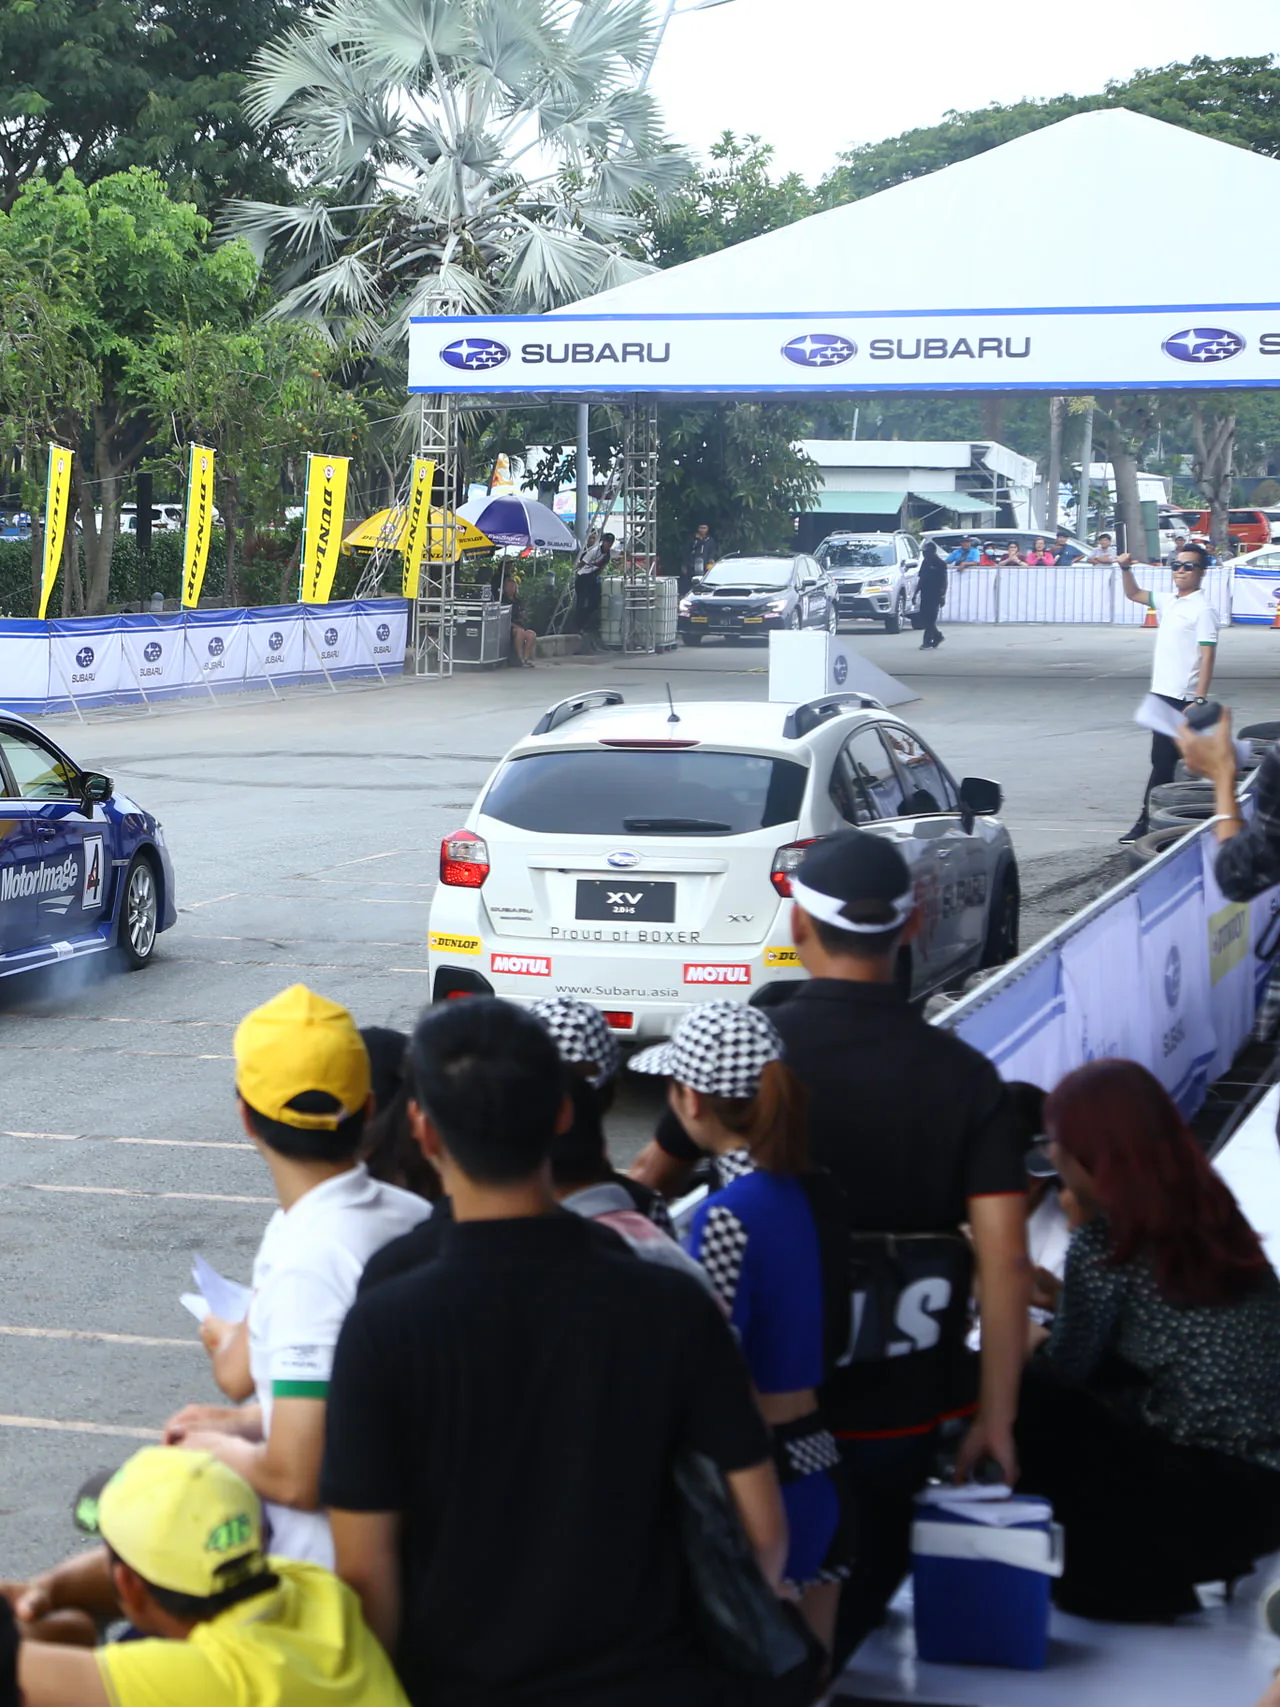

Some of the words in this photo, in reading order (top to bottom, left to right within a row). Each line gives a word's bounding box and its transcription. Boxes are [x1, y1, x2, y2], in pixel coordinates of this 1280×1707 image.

[521, 342, 671, 364] SUBARU
[869, 337, 1032, 360] SUBARU
[187, 482, 207, 600] DUNLOP
[71, 672, 96, 683] SUBARU
[139, 667, 164, 677] SUBARU
[0, 853, 78, 902] MotorImage
[86, 843, 100, 900] 4
[606, 892, 644, 905] XV
[727, 914, 755, 923] XV
[551, 927, 603, 941] Proud
[613, 930, 628, 942] of
[639, 931, 701, 943] BOXER
[437, 938, 479, 949] DUNLOP
[493, 956, 550, 974] MOTUL
[686, 966, 749, 983] MOTUL
[555, 983, 680, 998] www.Subaru.asia
